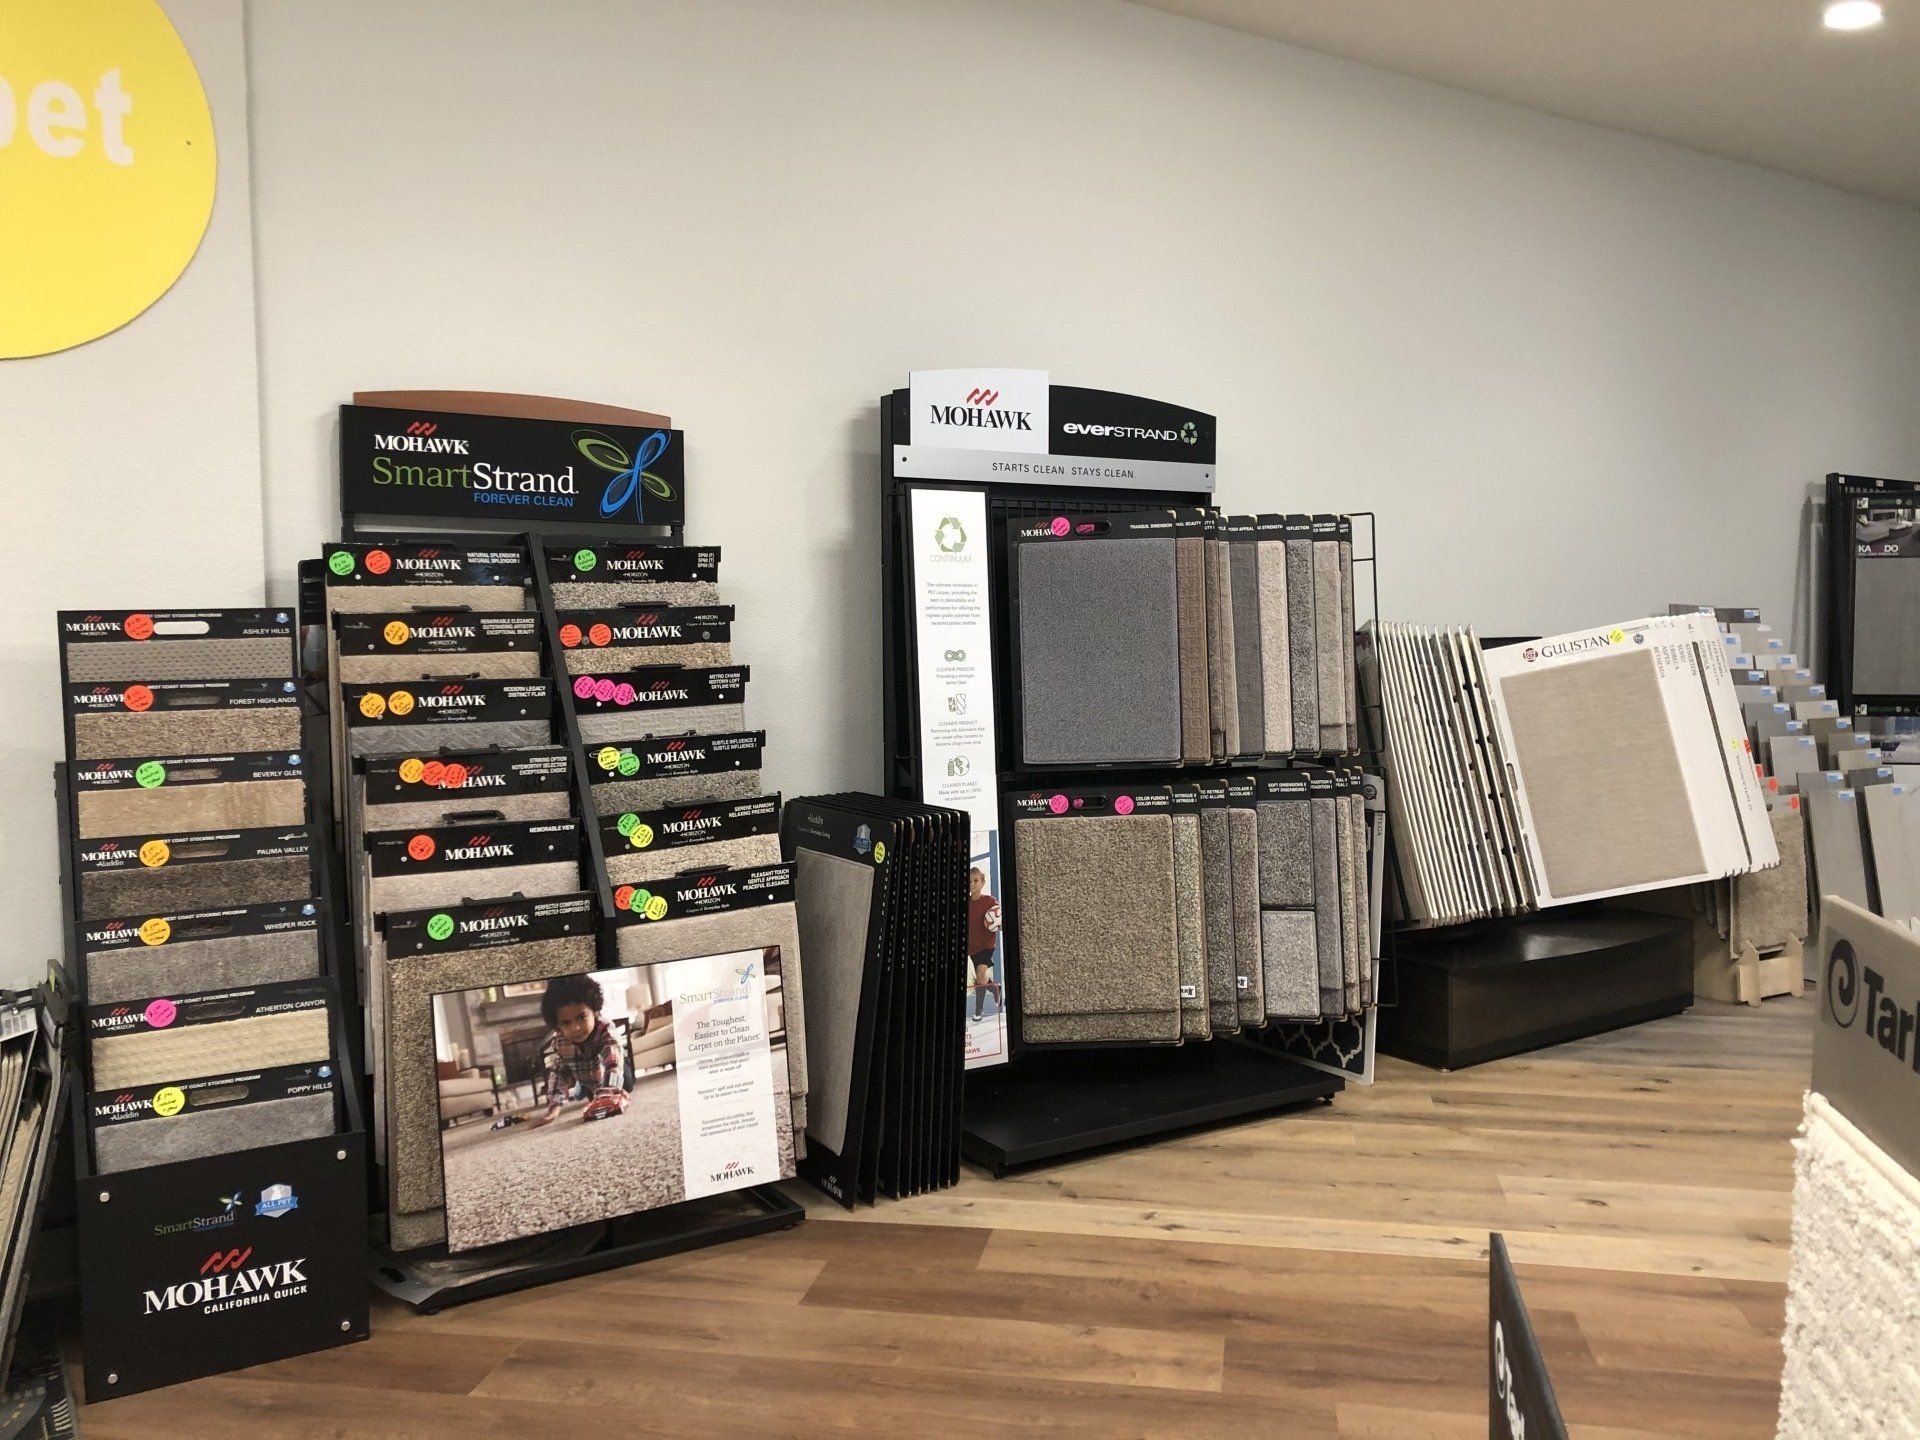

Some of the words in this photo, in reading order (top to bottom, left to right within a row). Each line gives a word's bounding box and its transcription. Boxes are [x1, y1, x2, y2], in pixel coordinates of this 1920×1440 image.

[930, 405, 1032, 430] MOHAWK
[374, 434, 469, 455] MOHAWK
[372, 457, 579, 495] SmartStrand
[992, 462, 1029, 473] STARTS
[1033, 463, 1068, 475] CLEAN.
[1071, 466, 1101, 477] STAYS
[1104, 467, 1137, 479] CLEAN.
[474, 492, 530, 506] FOREVER
[534, 496, 573, 507] CLEAN
[1021, 529, 1054, 537] MOHAW
[396, 558, 461, 570] MOHAWK
[607, 560, 664, 571] MOHAWK
[66, 623, 121, 632] MOHAWK
[409, 627, 475, 638] MOHAWK
[613, 625, 682, 640] MOHAWK
[1541, 635, 1610, 657] GULISTAN
[419, 694, 486, 707] MOHAWK
[631, 689, 688, 703] MOHAWK
[647, 750, 706, 765] MOHAWK
[78, 770, 133, 781] MOHAWK
[752, 807, 774, 815] PRESENCE
[663, 816, 722, 834] MOHAWK
[81, 849, 138, 862] MOHAWK
[445, 844, 514, 861] MOHAWK
[748, 877, 765, 885] GENTLE
[766, 874, 789, 882] APPROACH
[751, 870, 774, 878] PLEASANT
[743, 883, 766, 891] PEACEFUL
[767, 880, 789, 888] ELEGANCE
[677, 884, 737, 902] MOHAWK
[264, 922, 296, 930] WHISPER
[460, 914, 529, 934] MOHAWK
[86, 928, 141, 942] MOHAWK
[256, 1003, 294, 1013] ATHERTON
[295, 999, 325, 1008] CANYON
[92, 1013, 147, 1028] MOHAWK
[696, 1021, 710, 1029] The
[712, 1015, 746, 1027] Toughest,
[694, 1030, 719, 1040] Easiest
[730, 1025, 750, 1033] Clean
[688, 1041, 712, 1052] Carpet
[725, 1037, 736, 1045] the
[288, 1086, 311, 1094] POPPY
[312, 1082, 333, 1090] HILLS
[95, 1098, 153, 1116] MOHAWK
[110, 1112, 139, 1121] Aladdin
[710, 1167, 754, 1183] MOHAWK
[261, 1200, 274, 1210] ALL
[276, 1198, 292, 1208] PET
[154, 1210, 235, 1236] SmartStrand
[143, 1258, 308, 1315] MOHAWK
[204, 1293, 270, 1315] CALIFORNIA
[274, 1285, 308, 1300] QUICK
